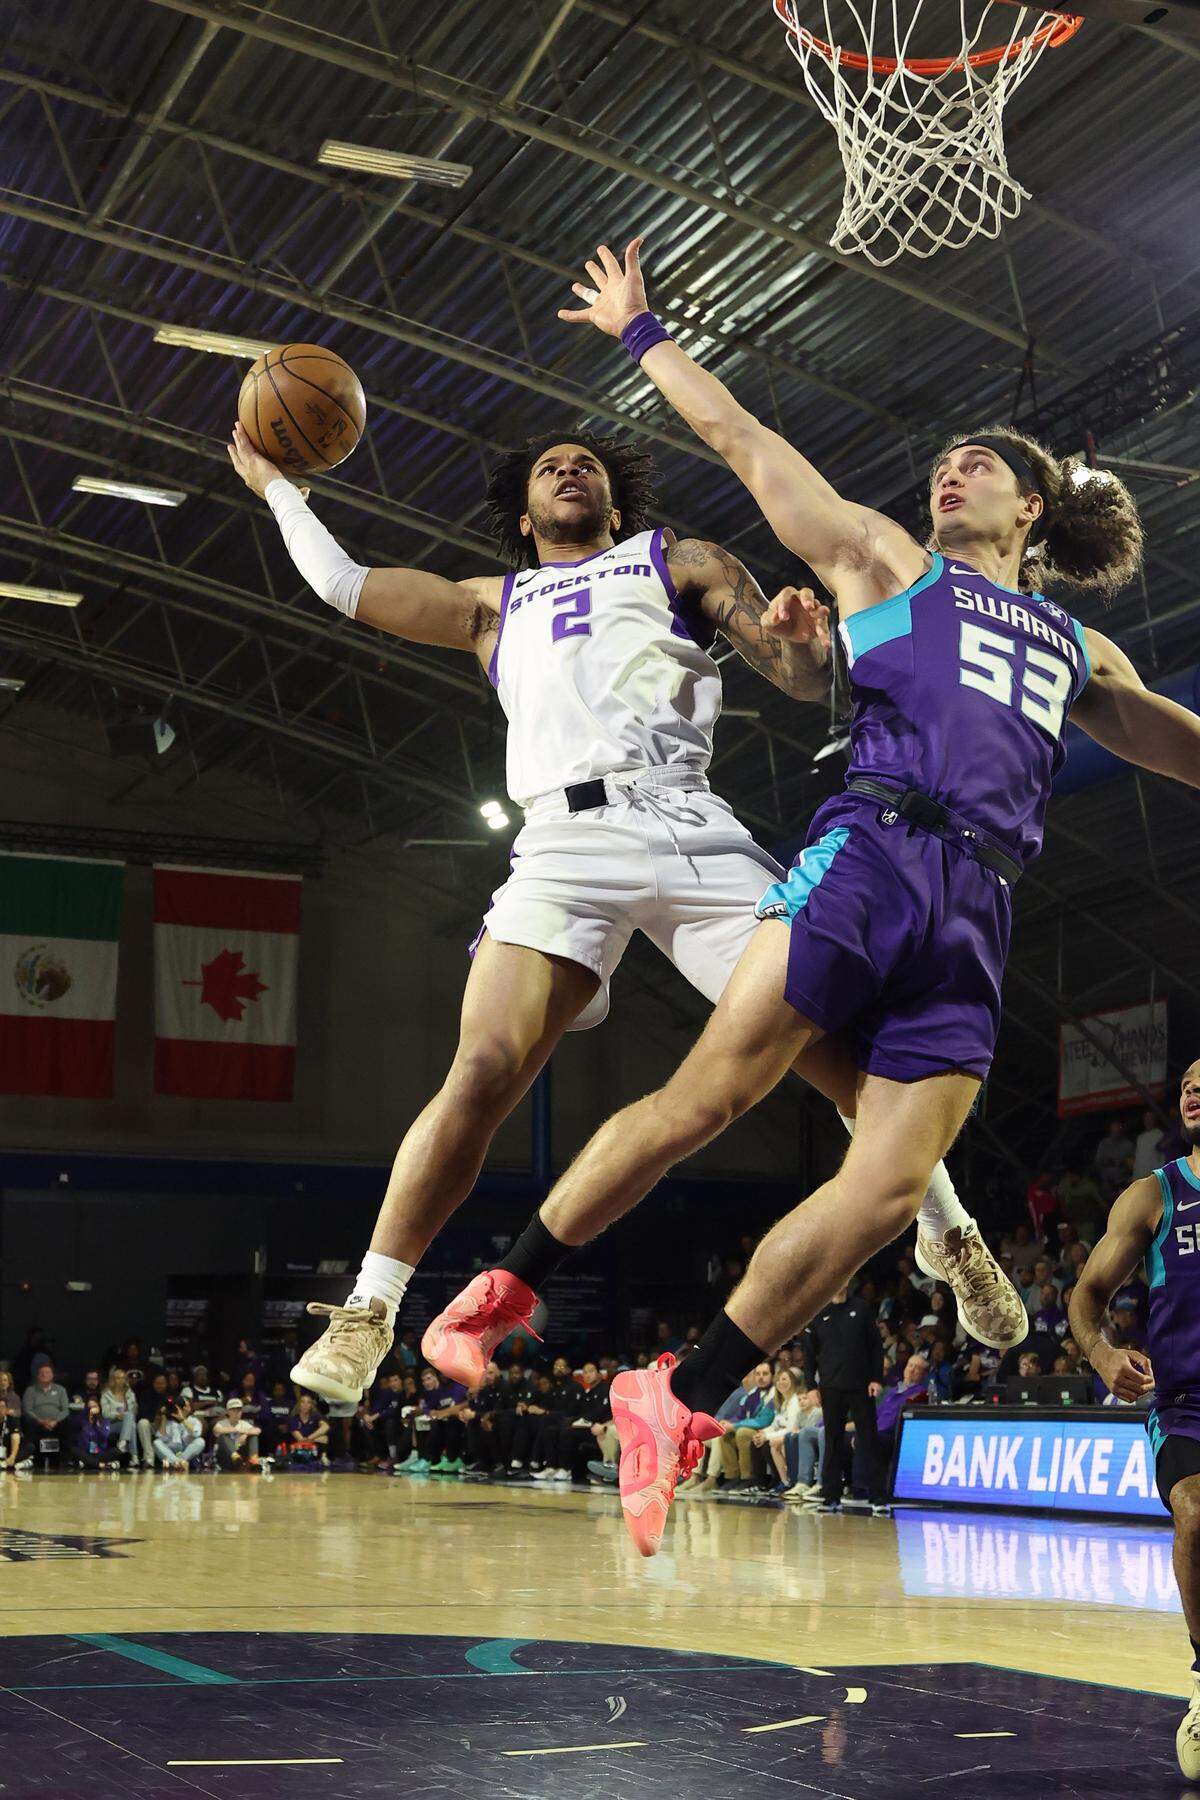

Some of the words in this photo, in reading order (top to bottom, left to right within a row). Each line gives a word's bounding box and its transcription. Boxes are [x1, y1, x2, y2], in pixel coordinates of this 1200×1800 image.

[510, 564, 651, 614] STOCKTON
[552, 587, 592, 644] 2
[951, 585, 1078, 670] SWARM
[960, 620, 1073, 741] 53
[922, 1433, 1024, 1490] BANK
[1027, 1436, 1115, 1495] LIKE
[1116, 1439, 1160, 1499] A
